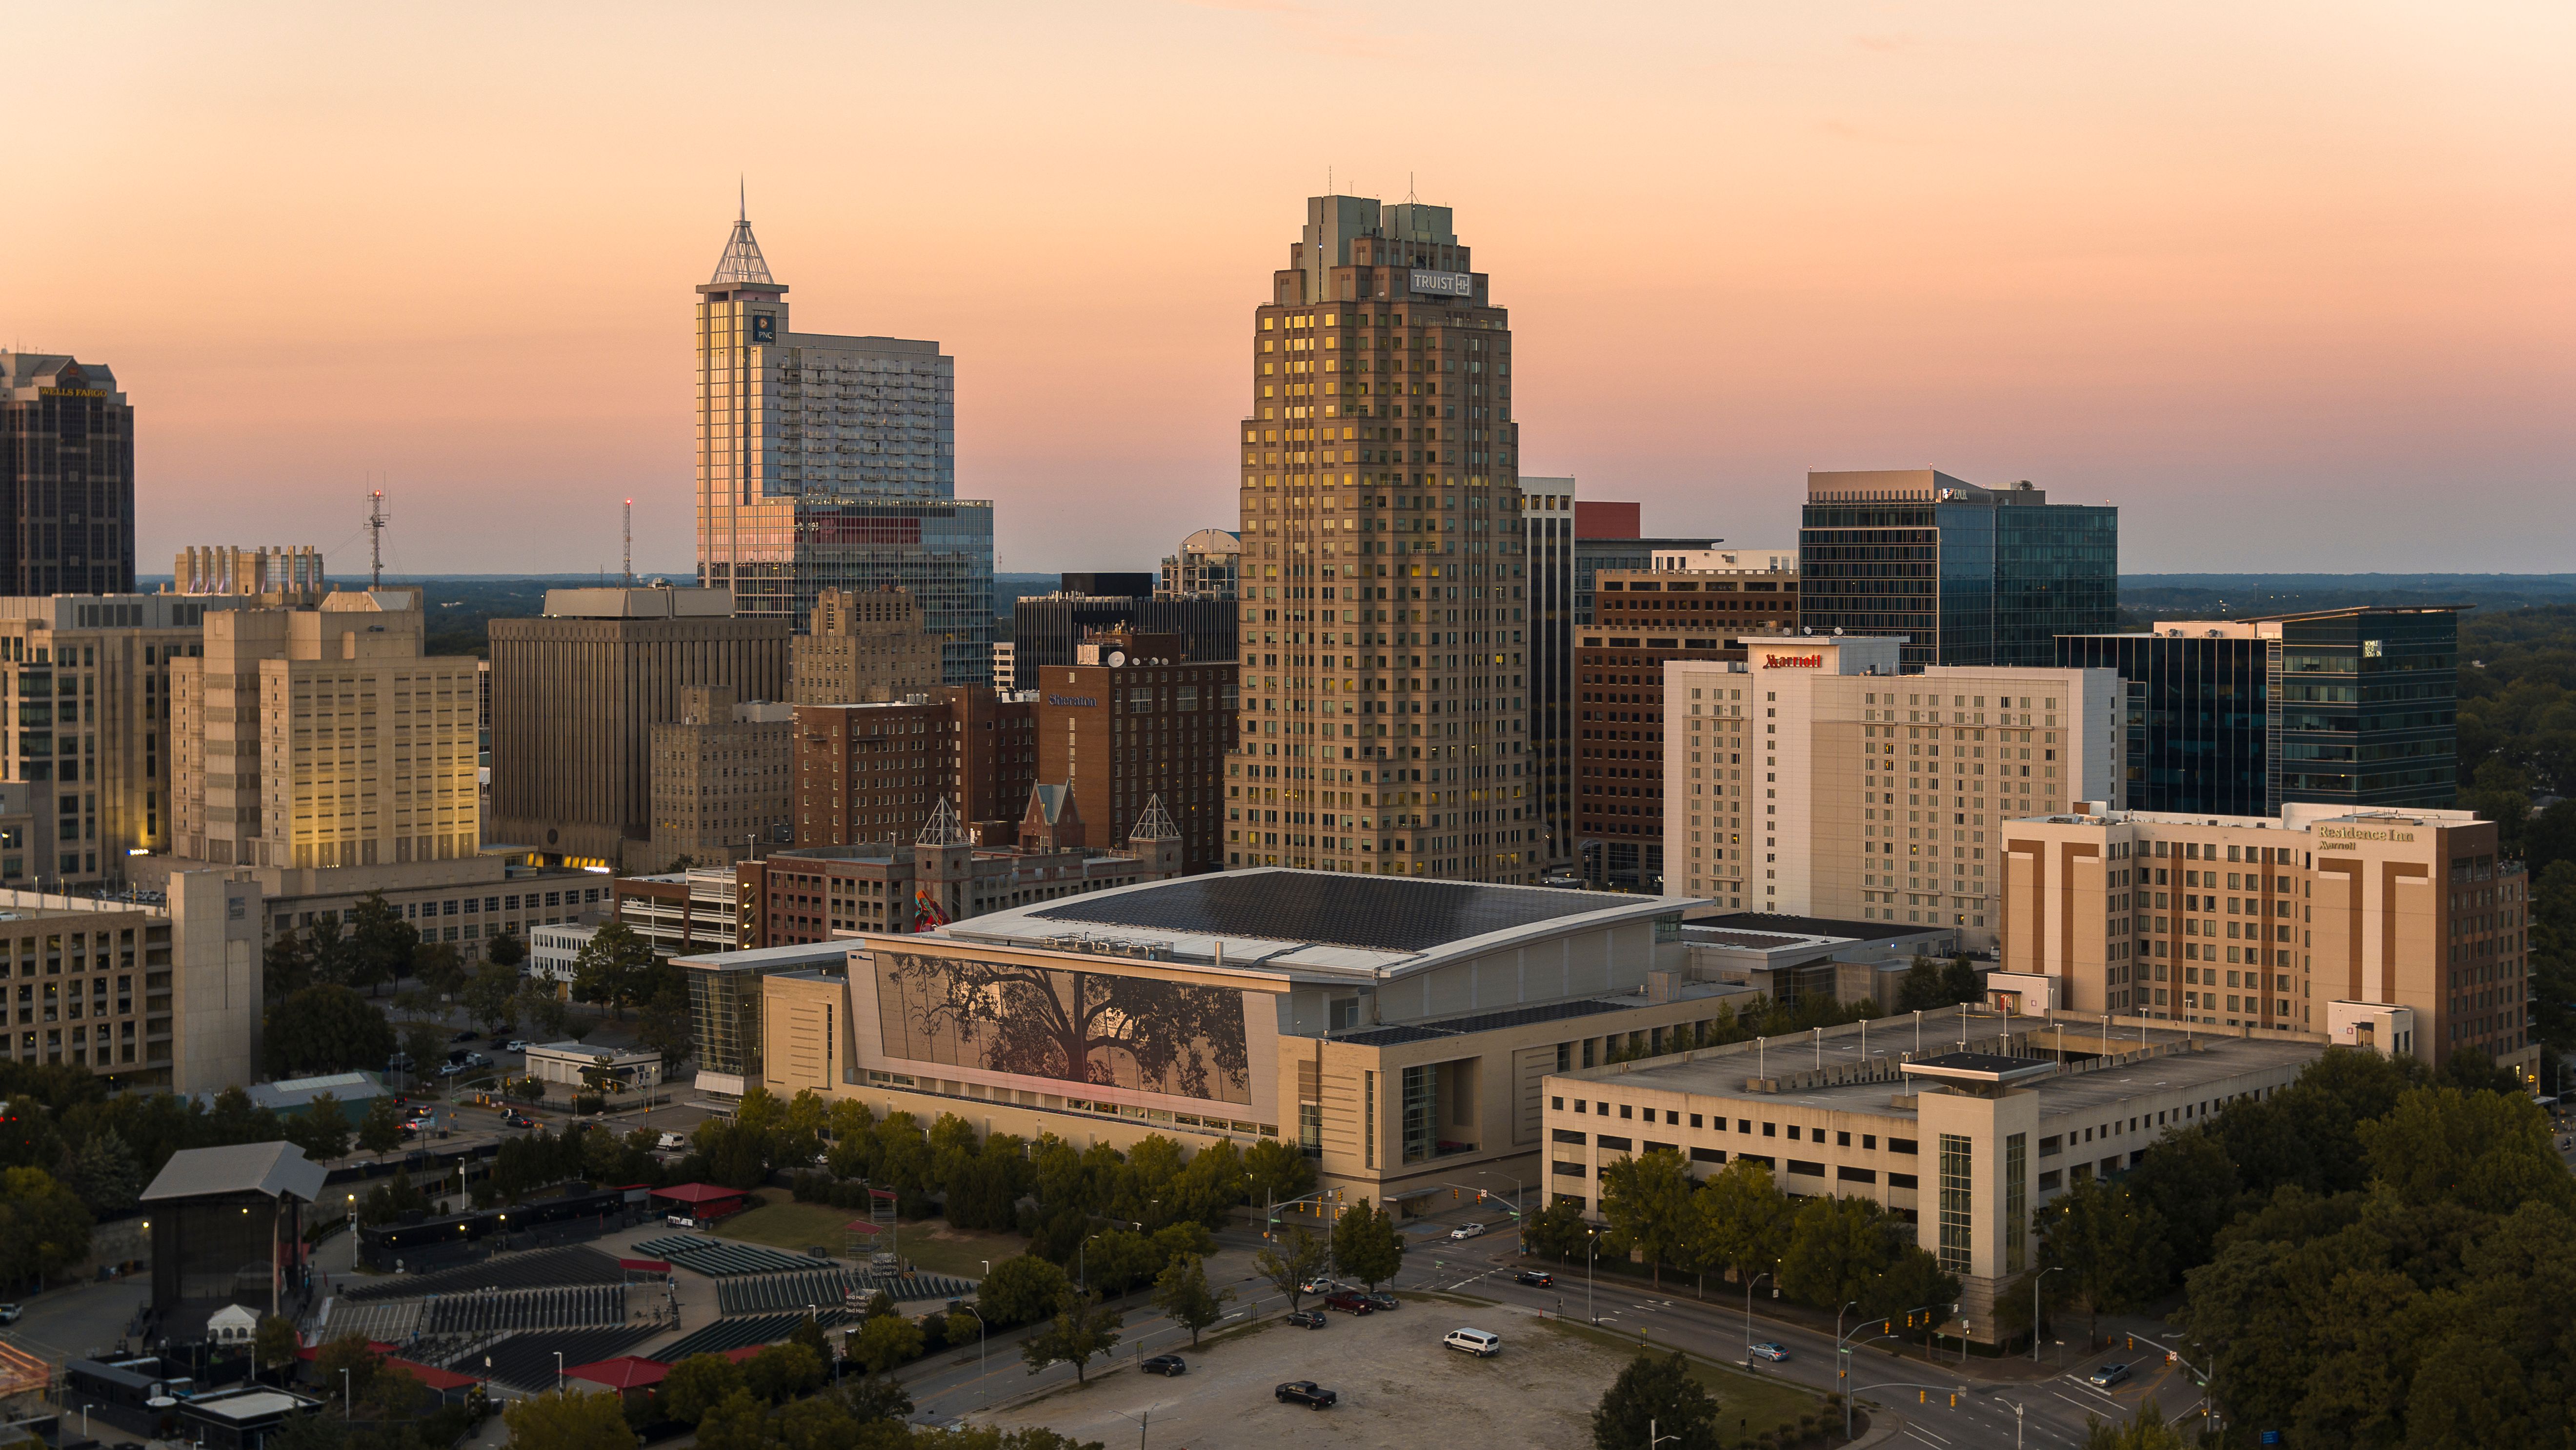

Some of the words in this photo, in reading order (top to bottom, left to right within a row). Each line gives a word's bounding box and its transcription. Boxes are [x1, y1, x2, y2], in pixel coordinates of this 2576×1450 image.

[1414, 274, 1453, 290] TRUIST
[40, 387, 73, 396] WELLS
[76, 389, 107, 397] FARGO
[1763, 654, 1821, 669] Marriott
[1049, 694, 1097, 706] Sheraton
[2318, 826, 2387, 841] Residence
[2389, 829, 2415, 842] Inn
[2318, 841, 2356, 850] Marriott
